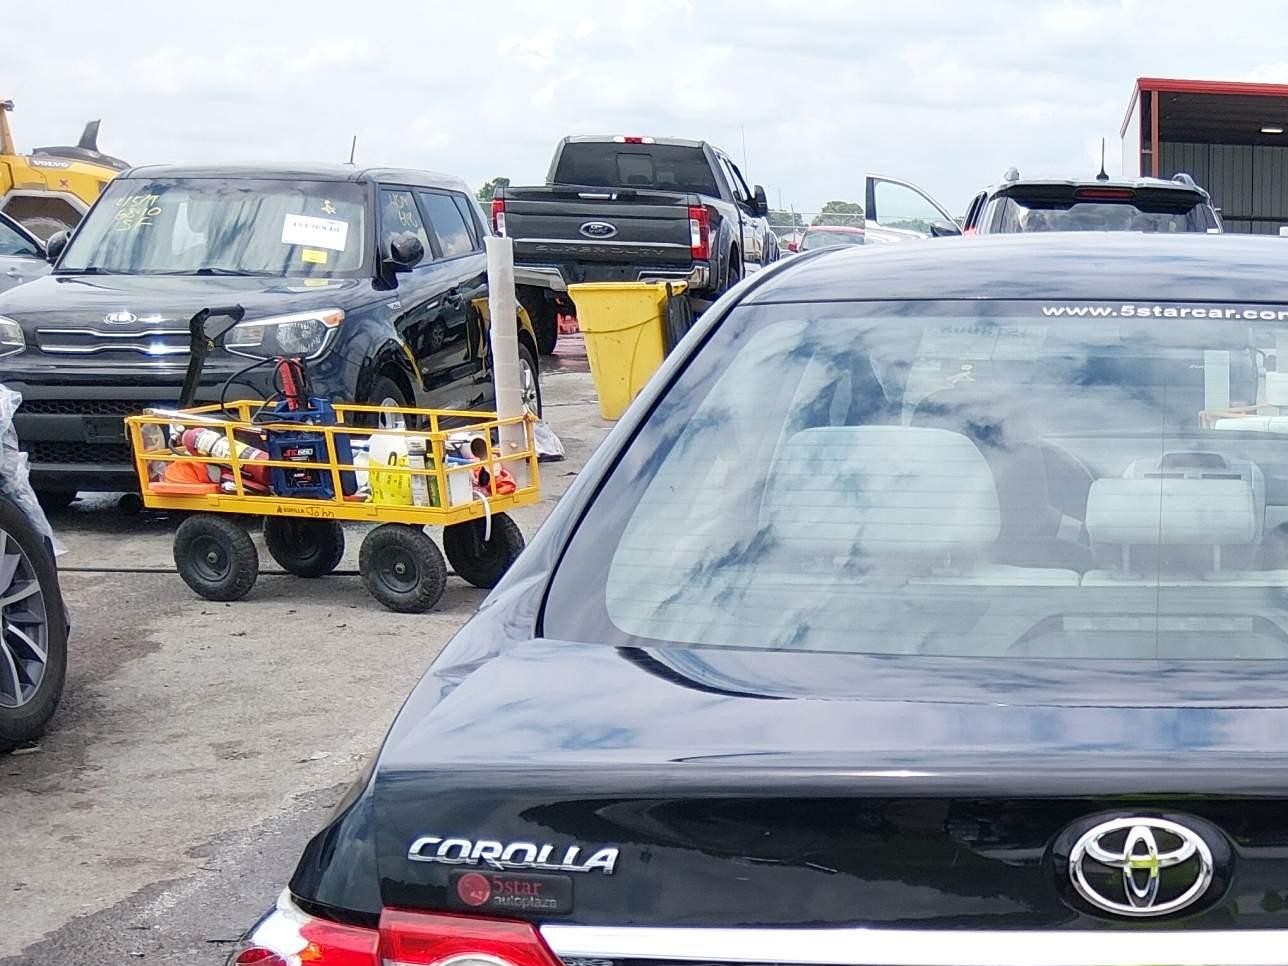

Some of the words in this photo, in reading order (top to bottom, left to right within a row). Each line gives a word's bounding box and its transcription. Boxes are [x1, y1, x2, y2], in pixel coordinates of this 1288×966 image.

[33, 160, 69, 168] VOLVO
[306, 506, 335, 518] John
[408, 836, 620, 875] COROLLA
[492, 874, 543, 896] 5star
[493, 893, 558, 909] autoplaza
